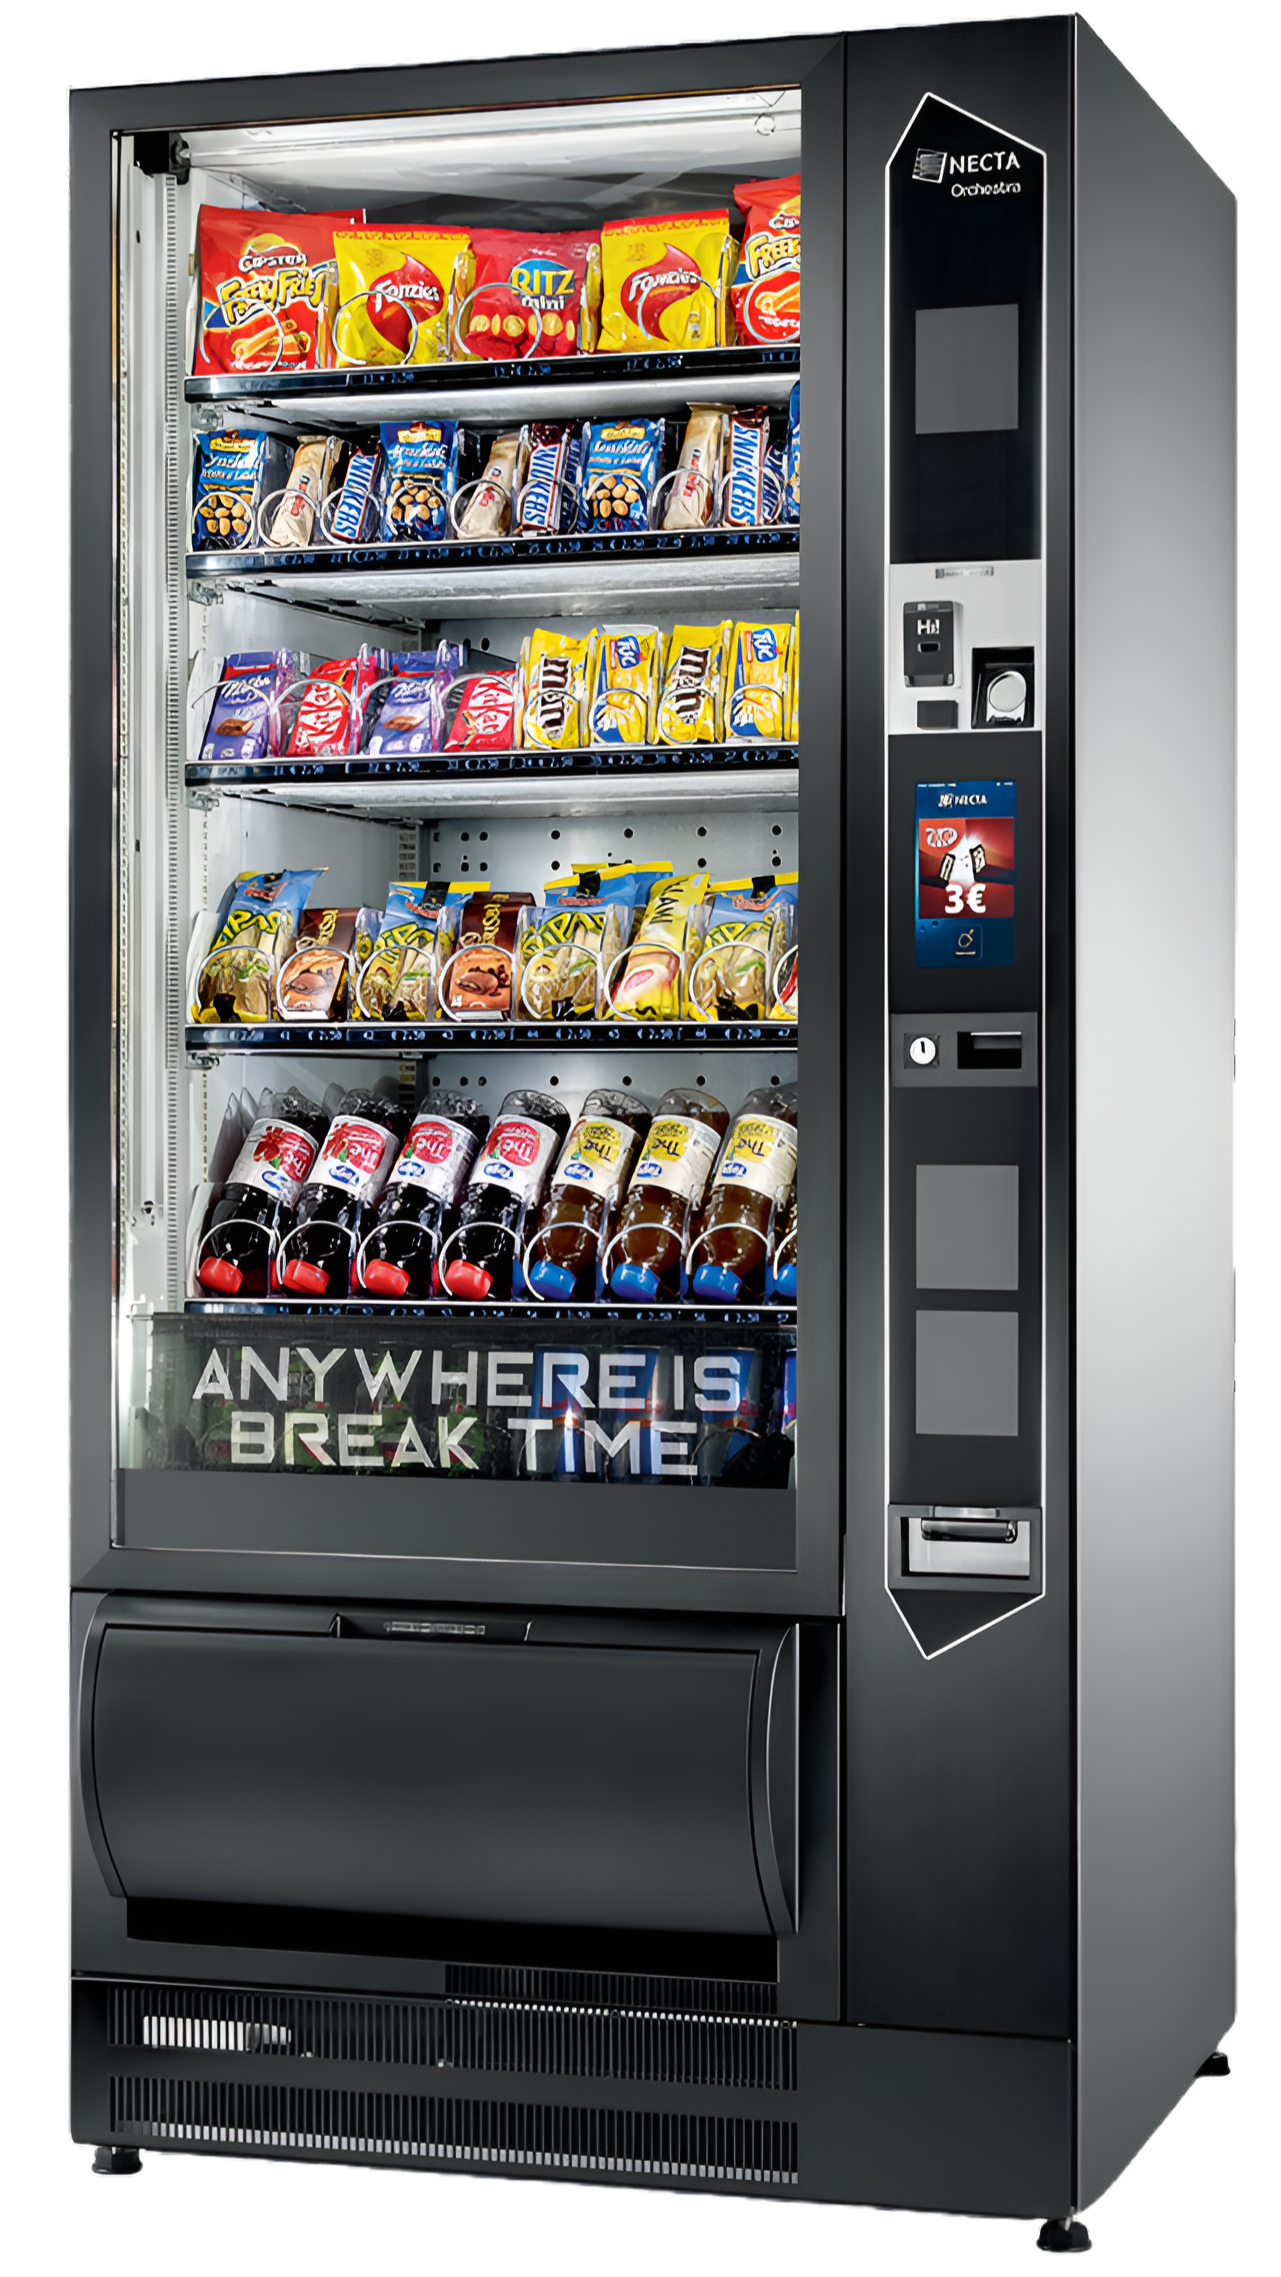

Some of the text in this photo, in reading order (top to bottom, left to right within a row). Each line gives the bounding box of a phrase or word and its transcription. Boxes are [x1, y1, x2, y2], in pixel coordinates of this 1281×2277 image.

[949, 151, 1020, 175] NECTA
[951, 181, 1021, 197] Orchestra
[375, 279, 440, 313] Fonzies
[511, 268, 575, 296] RITZ
[521, 295, 565, 310] mini
[730, 424, 759, 526] SNICKERS
[944, 883, 987, 914] 3€
[192, 1346, 741, 1412] ANYWHERE IS
[230, 1411, 698, 1476] BREAK TIME
